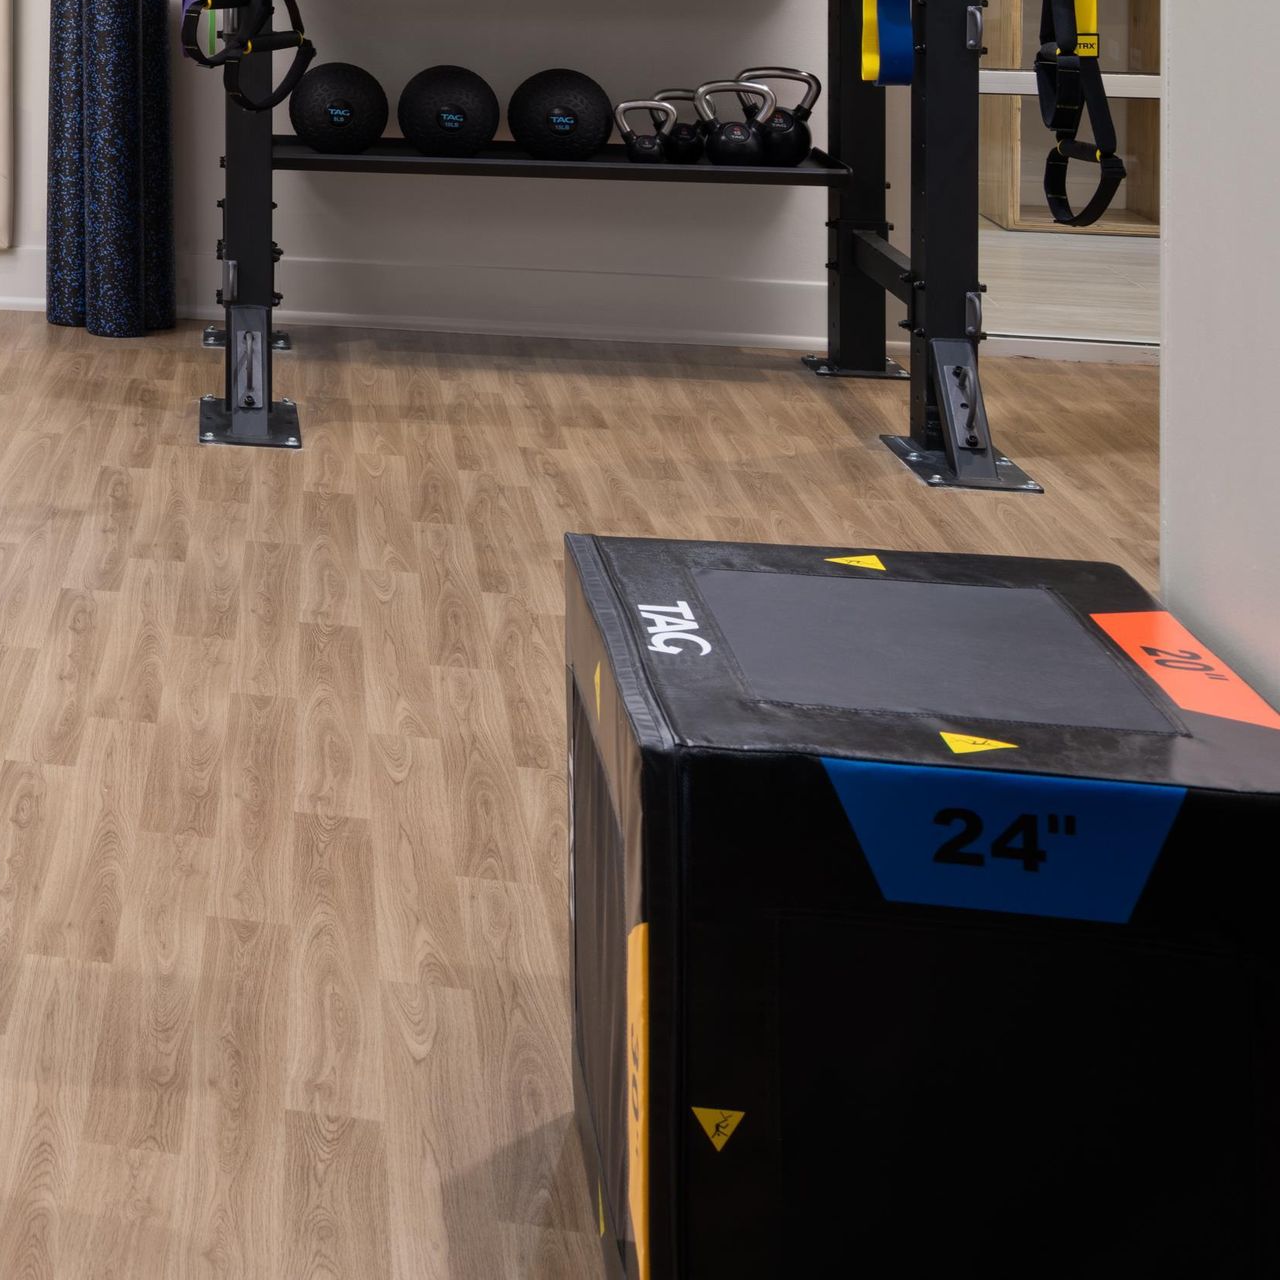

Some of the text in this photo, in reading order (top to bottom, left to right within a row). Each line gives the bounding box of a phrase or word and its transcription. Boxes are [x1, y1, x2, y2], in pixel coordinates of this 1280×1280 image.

[328, 108, 351, 116] TAG
[441, 113, 464, 121] TAG
[550, 116, 574, 124] TAG
[637, 599, 712, 658] TAG
[1140, 643, 1229, 683] 20"
[932, 807, 1078, 872] 24"
